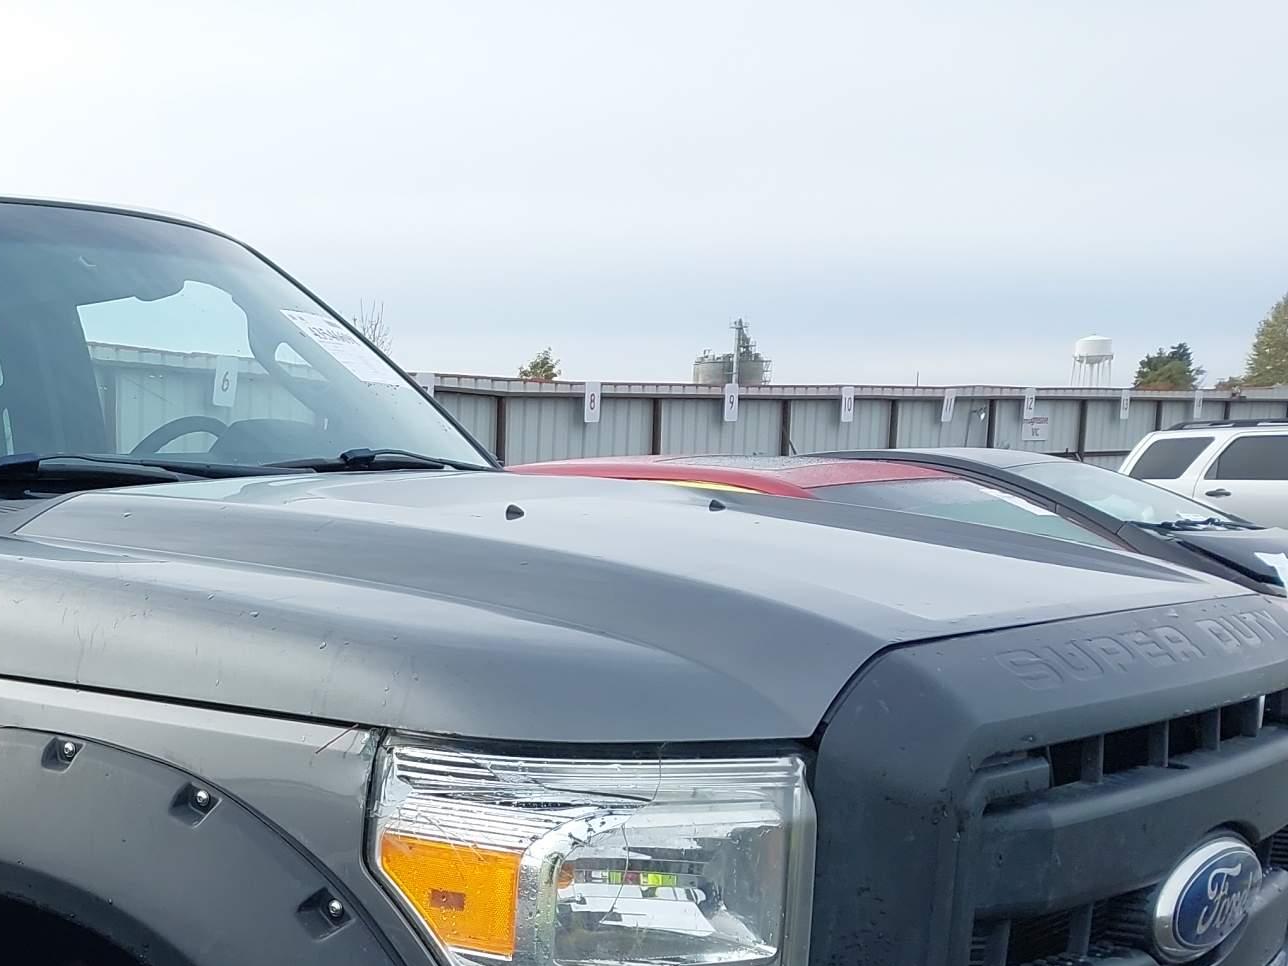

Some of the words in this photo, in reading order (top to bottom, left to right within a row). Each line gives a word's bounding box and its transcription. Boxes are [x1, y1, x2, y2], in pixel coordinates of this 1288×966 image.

[221, 371, 230, 392] 6
[589, 393, 596, 410] 8
[729, 394, 735, 410] 9
[844, 397, 853, 412] 10
[1026, 397, 1034, 410] 12
[994, 624, 1207, 691] SUPER
[1194, 609, 1288, 655] DUTY
[1196, 863, 1254, 935] Ford
